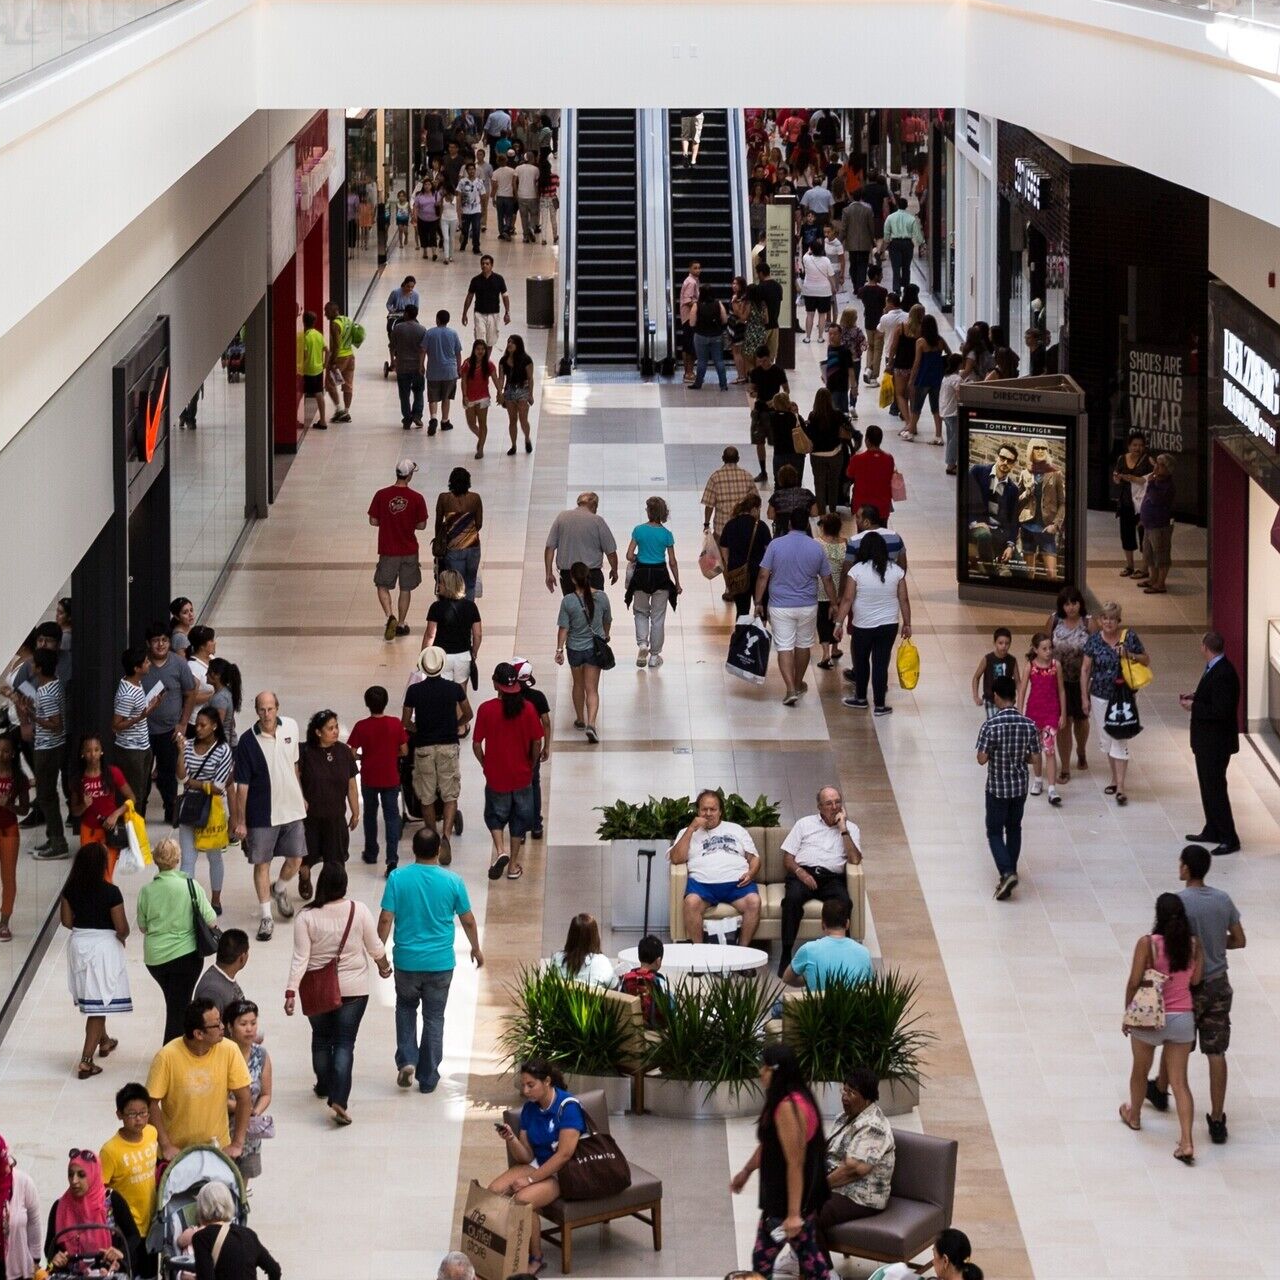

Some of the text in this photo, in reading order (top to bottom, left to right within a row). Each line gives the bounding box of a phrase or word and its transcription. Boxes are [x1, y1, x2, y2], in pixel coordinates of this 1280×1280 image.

[1130, 350, 1182, 376] SHOES ARE
[1223, 328, 1280, 416] HELZBERG
[993, 391, 1043, 402] DIRECTORY
[1129, 371, 1183, 402] BORING
[1129, 396, 1182, 432] WEAR
[985, 423, 1052, 434] TOMMY HILFIGER
[471, 1208, 487, 1225] the
[467, 1224, 492, 1248] outlet
[466, 1239, 487, 1260] store
